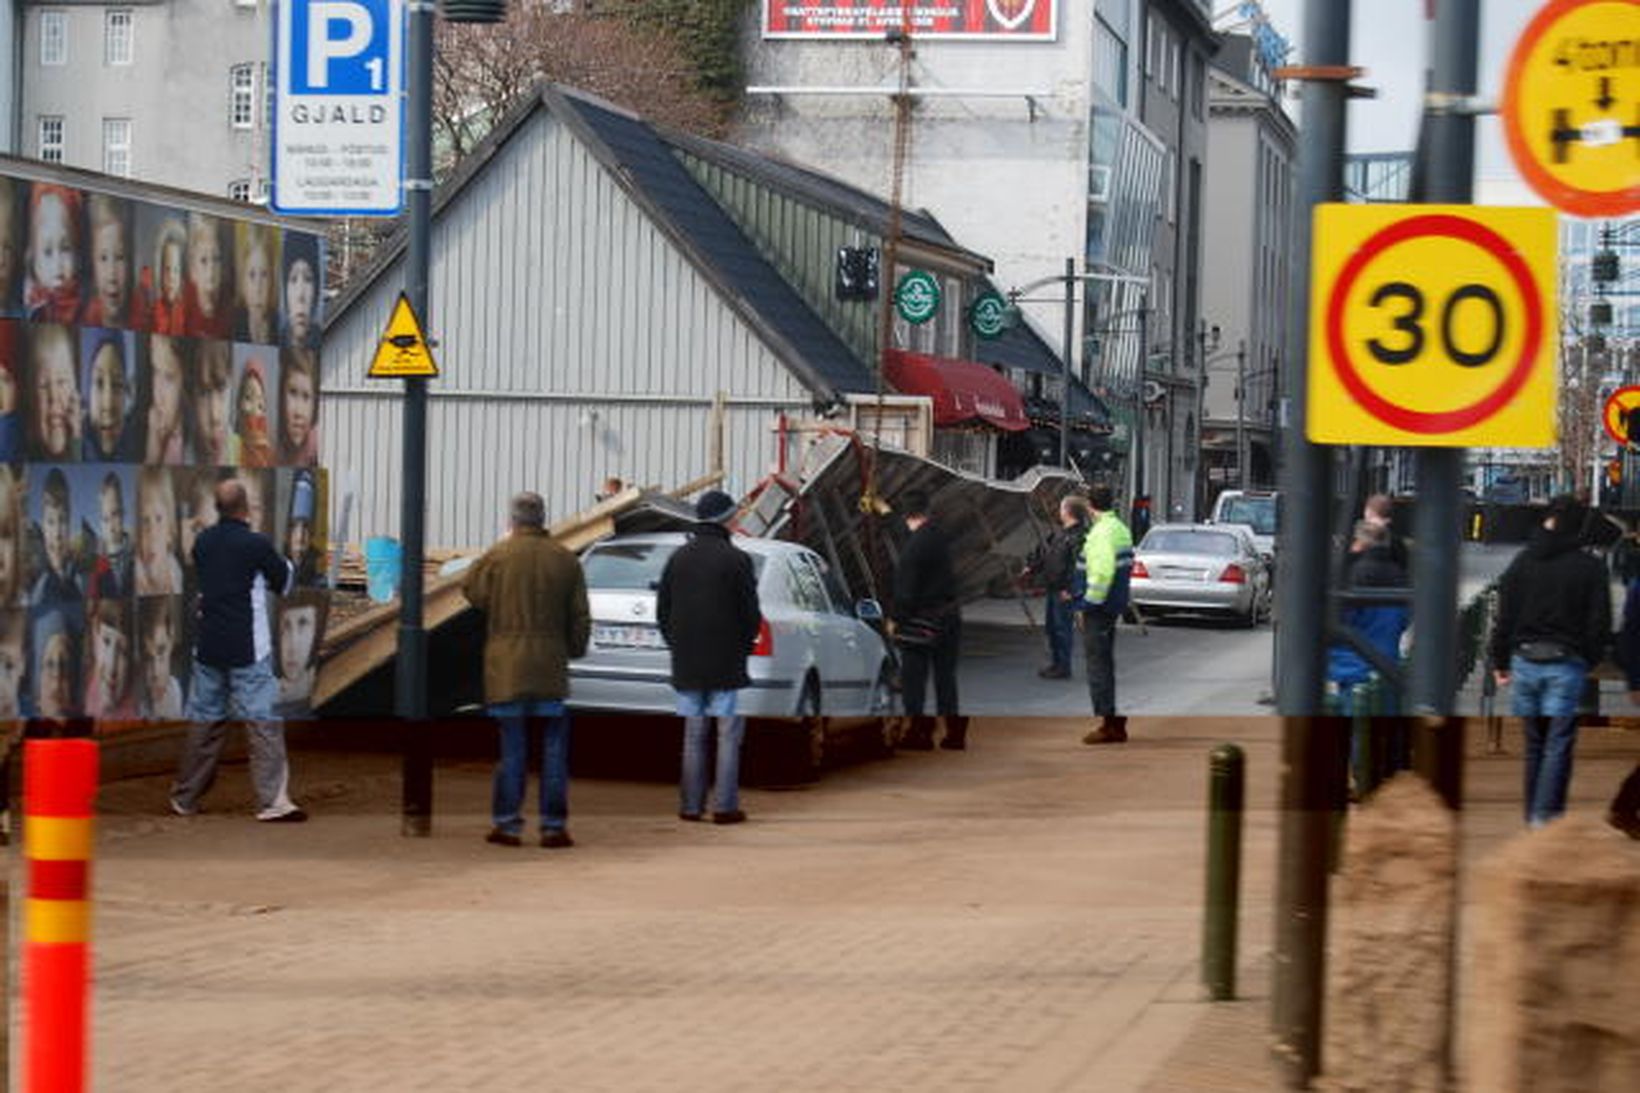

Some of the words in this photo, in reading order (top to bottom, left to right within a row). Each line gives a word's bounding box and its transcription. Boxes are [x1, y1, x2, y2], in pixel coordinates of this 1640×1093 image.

[307, 1, 373, 88] P
[291, 103, 387, 124] GJALD
[1366, 281, 1507, 368] 30
